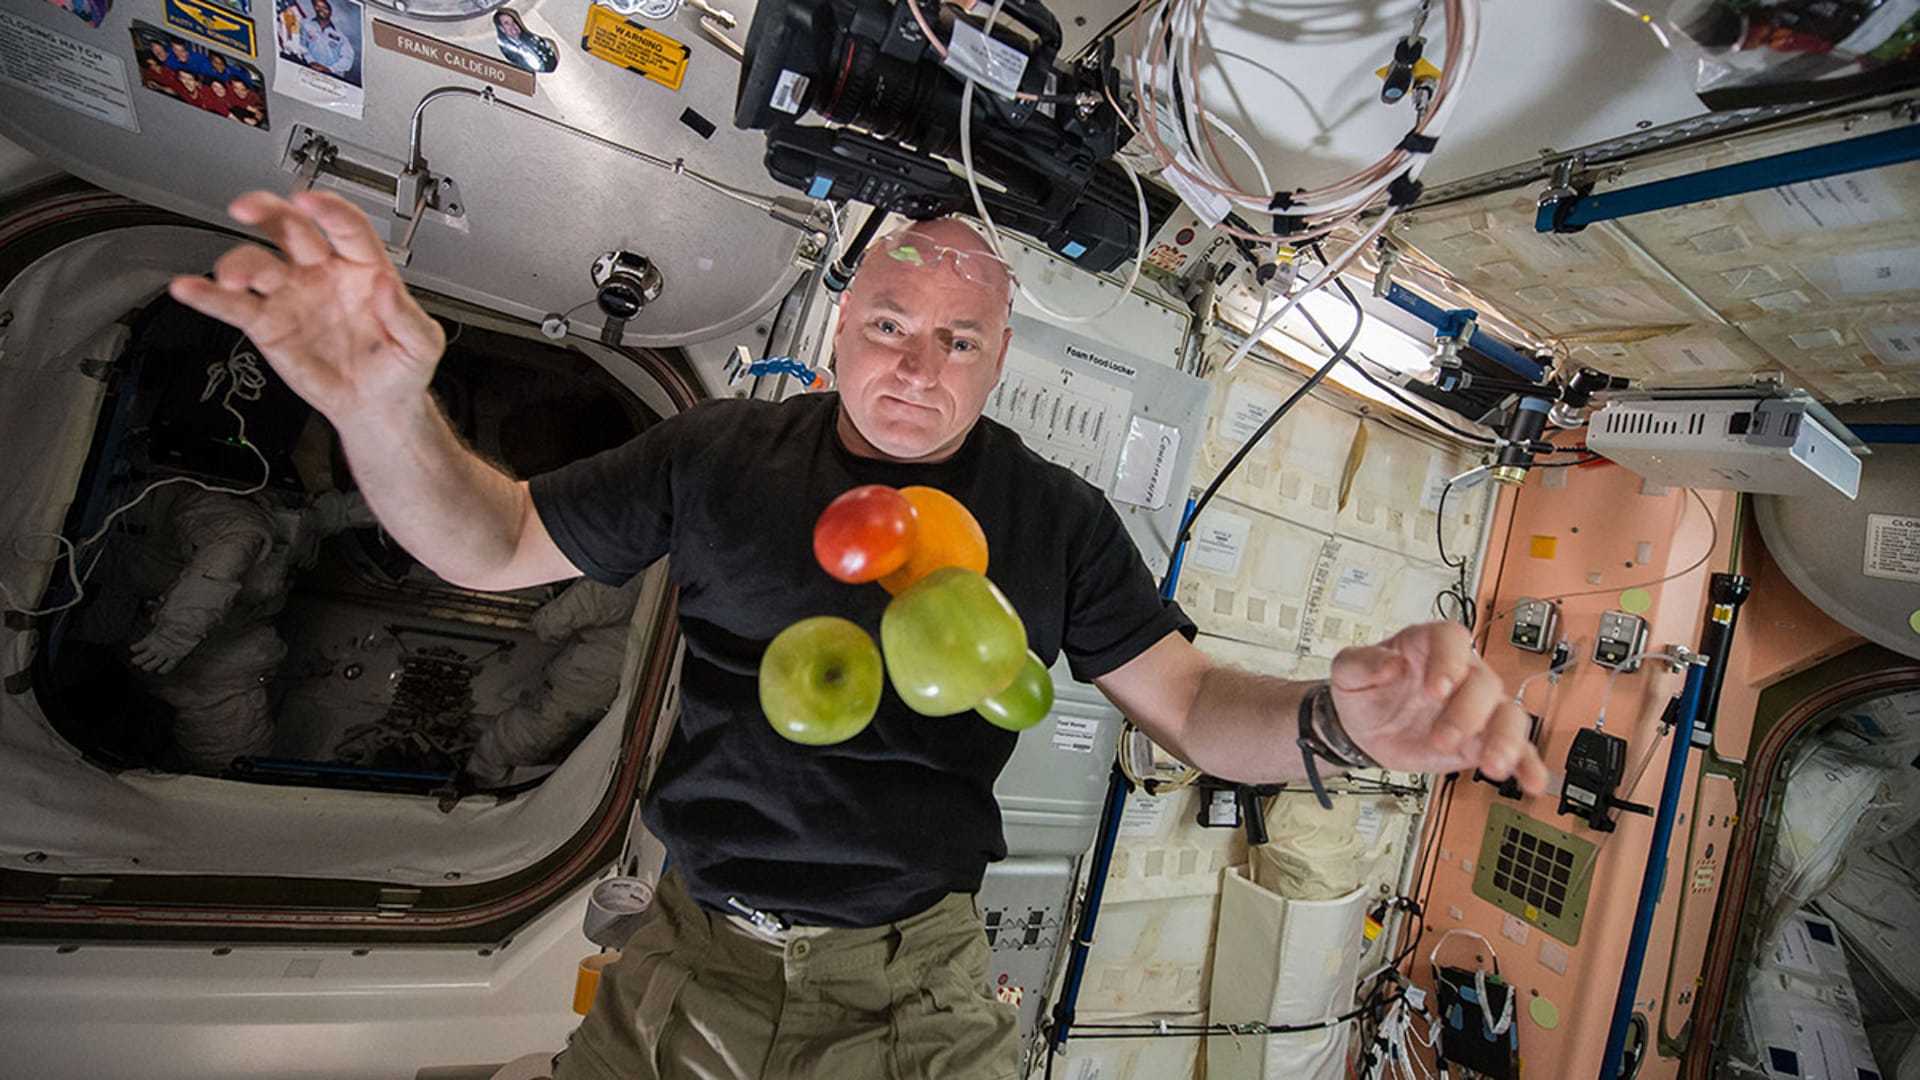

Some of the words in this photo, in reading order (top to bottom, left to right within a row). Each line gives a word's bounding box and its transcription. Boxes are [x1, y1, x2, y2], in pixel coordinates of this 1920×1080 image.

[59, 38, 104, 61] HATCH
[615, 25, 663, 53] WARNING
[397, 35, 440, 61] FRANK
[443, 51, 507, 83] CALDEIRO
[1066, 345, 1089, 361] Foam
[1089, 353, 1109, 369] Food
[1108, 360, 1136, 377] Locker
